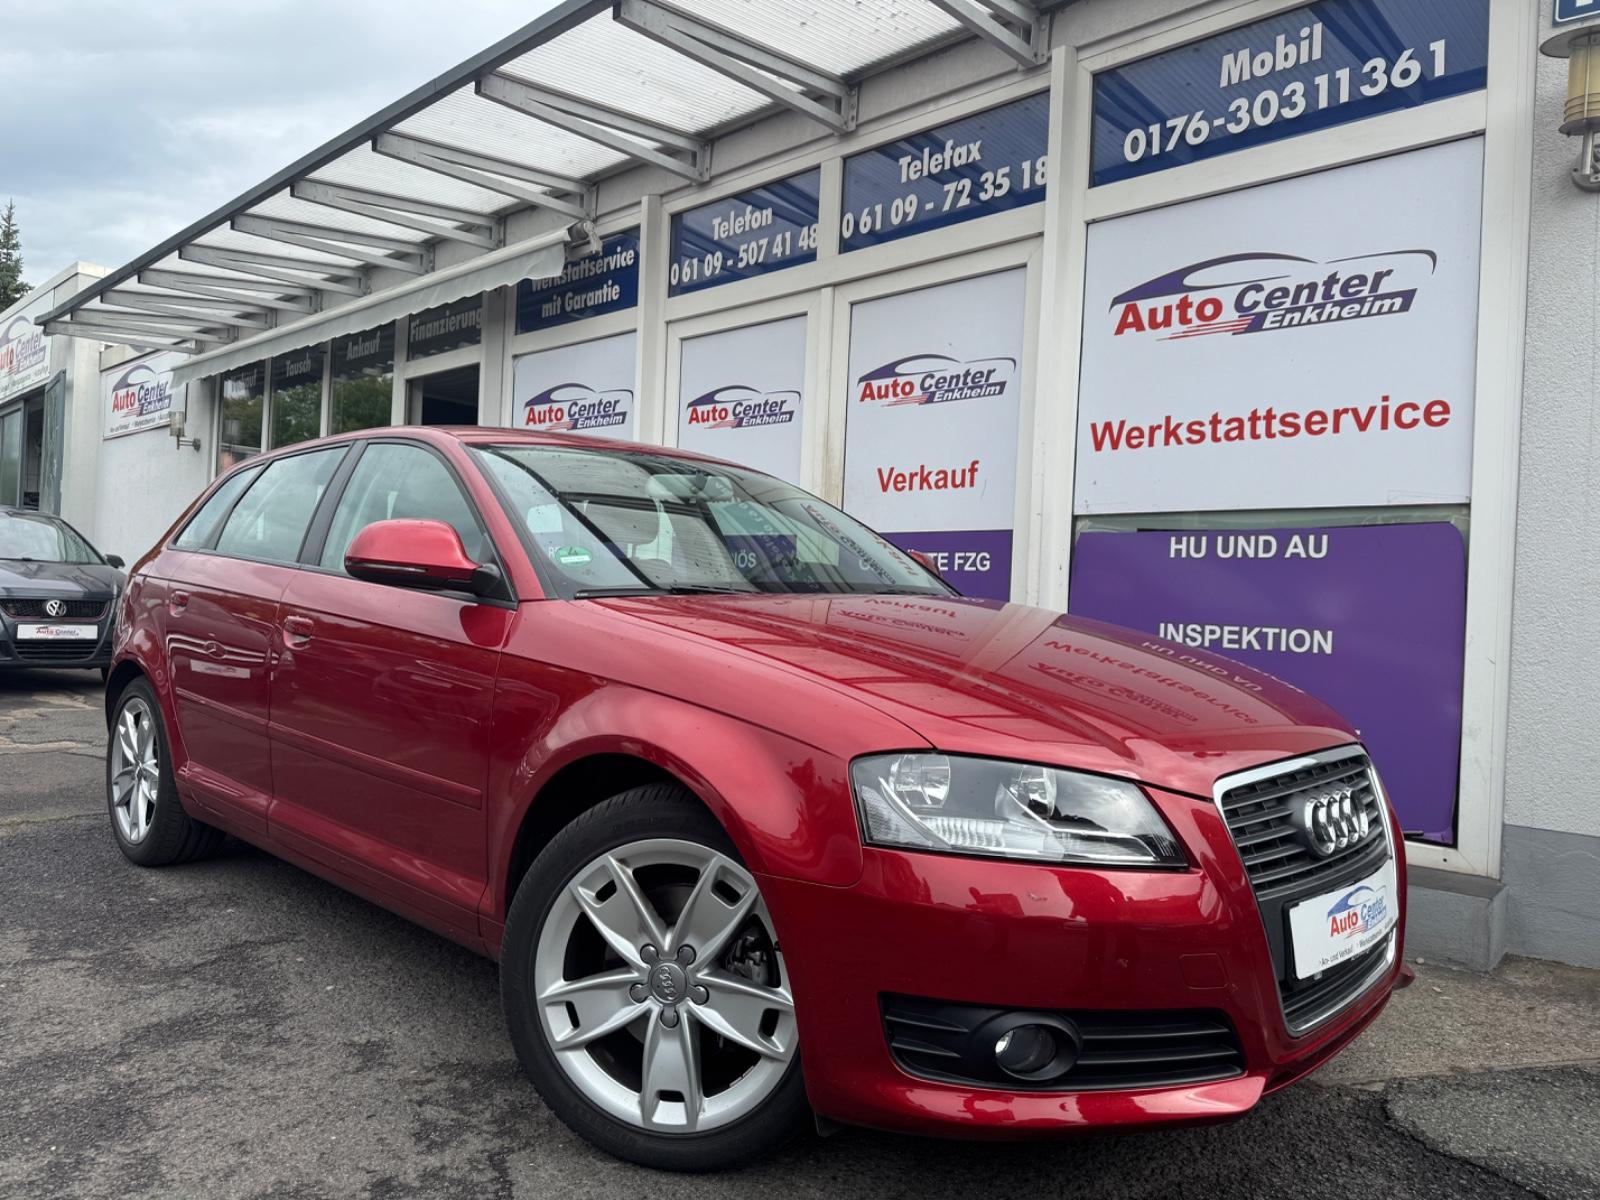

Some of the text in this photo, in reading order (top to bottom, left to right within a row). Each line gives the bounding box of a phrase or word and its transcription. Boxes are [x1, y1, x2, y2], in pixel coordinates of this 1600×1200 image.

[1219, 22, 1323, 88] Mobil
[899, 139, 982, 183] Telefax
[942, 178, 972, 212] 72
[979, 166, 1010, 201] 35
[1021, 155, 1048, 190] 18
[712, 205, 773, 241] Telefon
[737, 237, 769, 269] 507
[772, 231, 791, 257] 41
[542, 279, 620, 318] mit Garantie
[1113, 268, 1394, 336] Auto Center
[1262, 296, 1403, 329] Enkheim
[410, 307, 481, 342] Finanzierung
[0, 346, 14, 369] uto
[347, 330, 380, 361] Ankauf
[286, 352, 311, 378] Tausch
[112, 381, 168, 413] Auto Center
[859, 368, 997, 402] Auto Center
[933, 385, 1000, 402] Enkheim
[526, 398, 620, 425] Auto Center
[576, 414, 624, 428] Enkheim
[688, 398, 787, 425] Auto Center
[742, 412, 790, 427] Enkheim
[1090, 395, 1451, 452] Werkstattservice
[877, 460, 980, 493] Verkauf
[954, 552, 990, 571] FZG
[1169, 534, 1329, 559] HU UND AU
[1159, 622, 1333, 655] INSPEKTION
[1330, 911, 1358, 937] Auto
